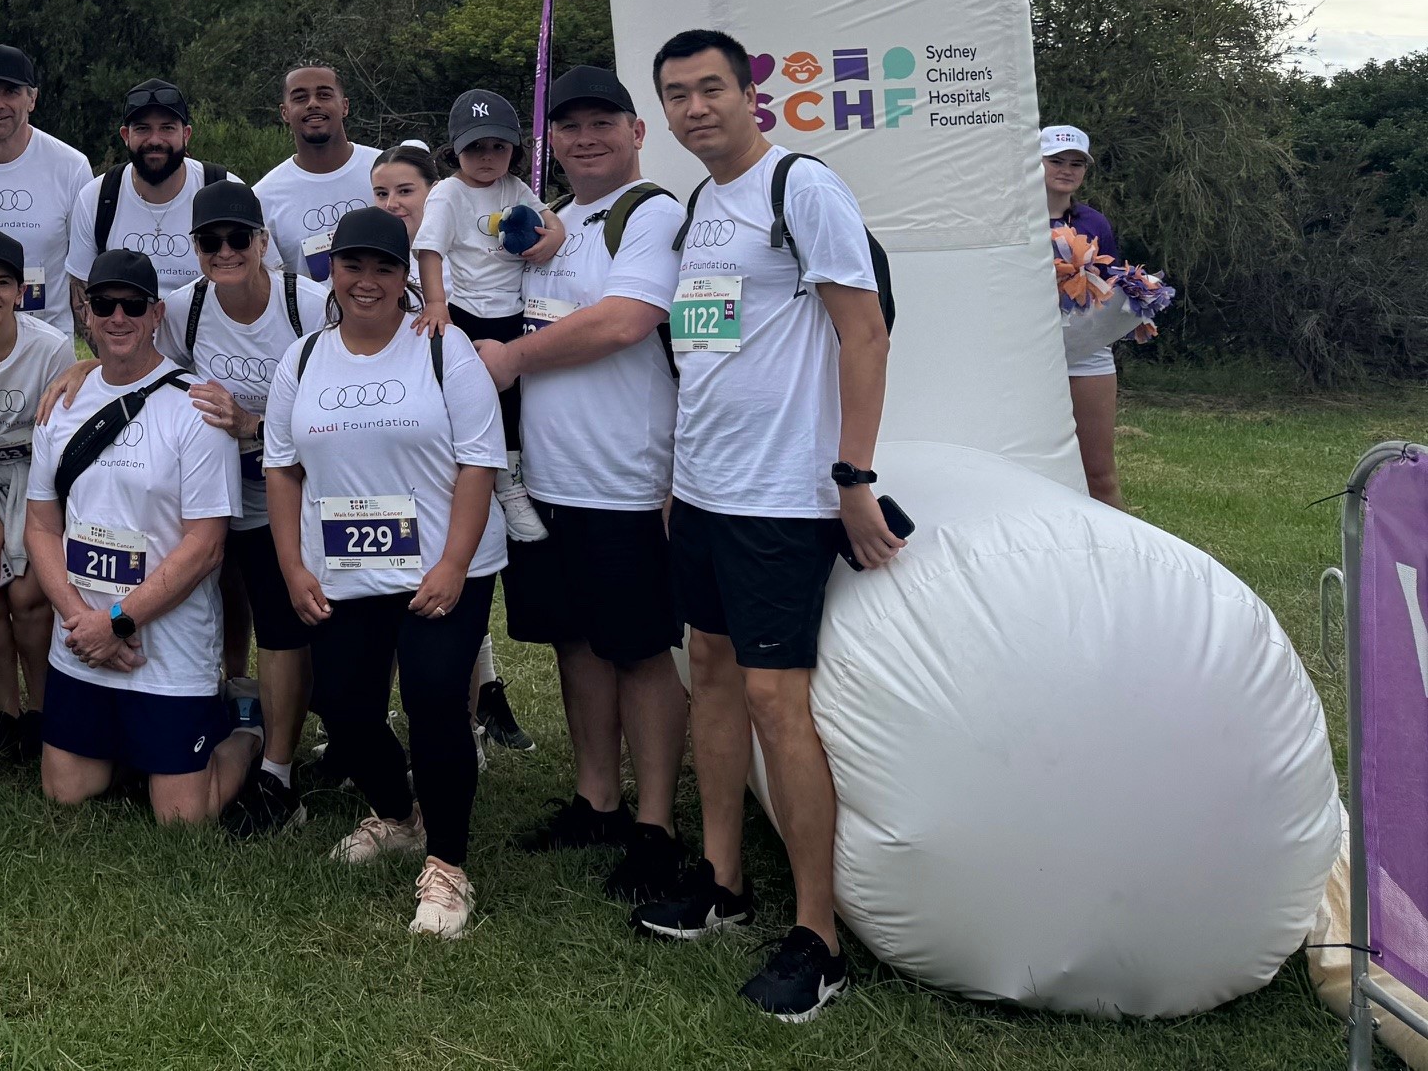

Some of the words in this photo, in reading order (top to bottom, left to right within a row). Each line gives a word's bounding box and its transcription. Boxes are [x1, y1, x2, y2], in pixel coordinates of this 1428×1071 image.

[925, 44, 977, 61] Sydney
[926, 66, 993, 83] Children's
[929, 88, 991, 107] Hospitals
[472, 102, 489, 117] NY
[753, 87, 917, 133] SCHF
[930, 111, 1004, 127] Foundation
[157, 268, 199, 276] ndation
[689, 260, 737, 270] Foundation
[683, 307, 719, 334] 1122
[233, 392, 267, 401] Found
[308, 423, 338, 434] Audi
[343, 418, 420, 431] Foundation
[94, 457, 145, 469] Foundation
[345, 526, 393, 553] 229
[85, 551, 117, 580] 211
[389, 558, 406, 566] VIP
[115, 585, 131, 594] VIP
